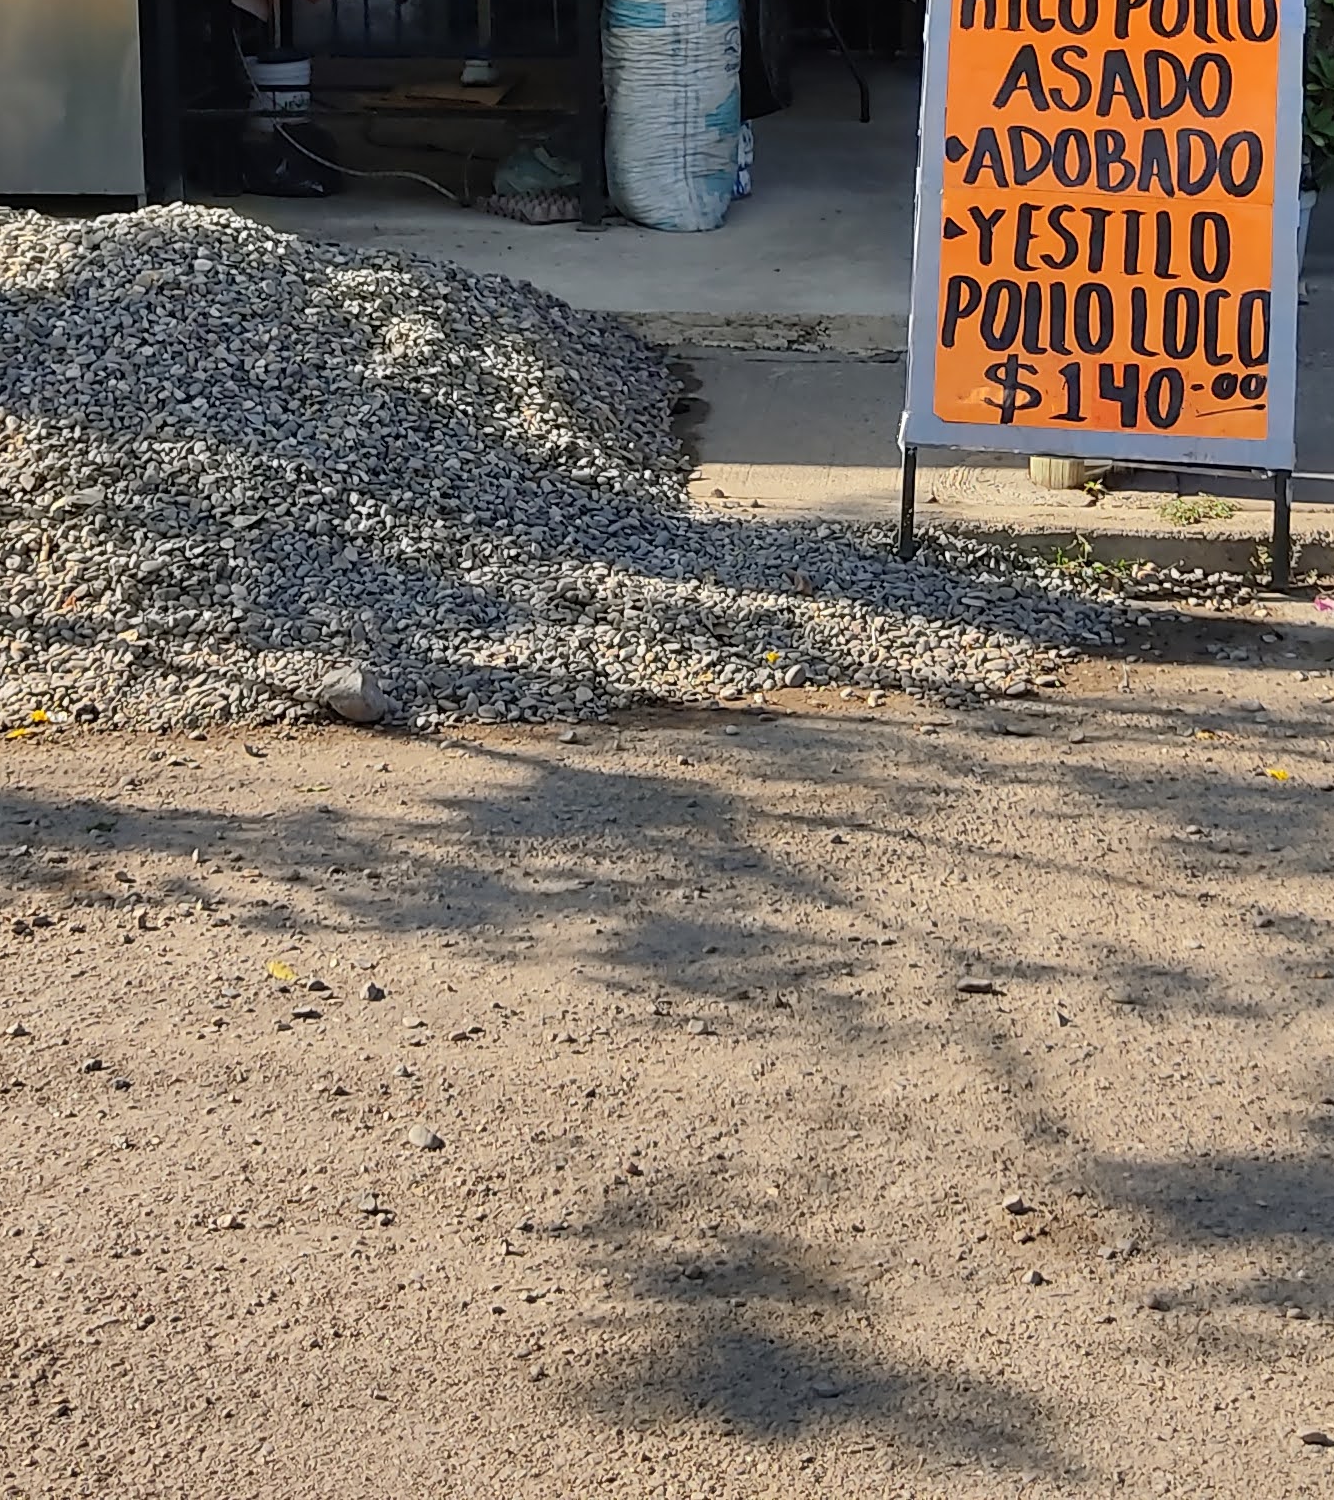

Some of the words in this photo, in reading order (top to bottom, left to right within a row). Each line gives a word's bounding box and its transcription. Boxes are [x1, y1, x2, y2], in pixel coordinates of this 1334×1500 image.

[992, 43, 1232, 120] ASADO
[963, 125, 1264, 198] ADOBADO
[941, 275, 1114, 356] POLLO
[1131, 287, 1271, 368] LOCO
